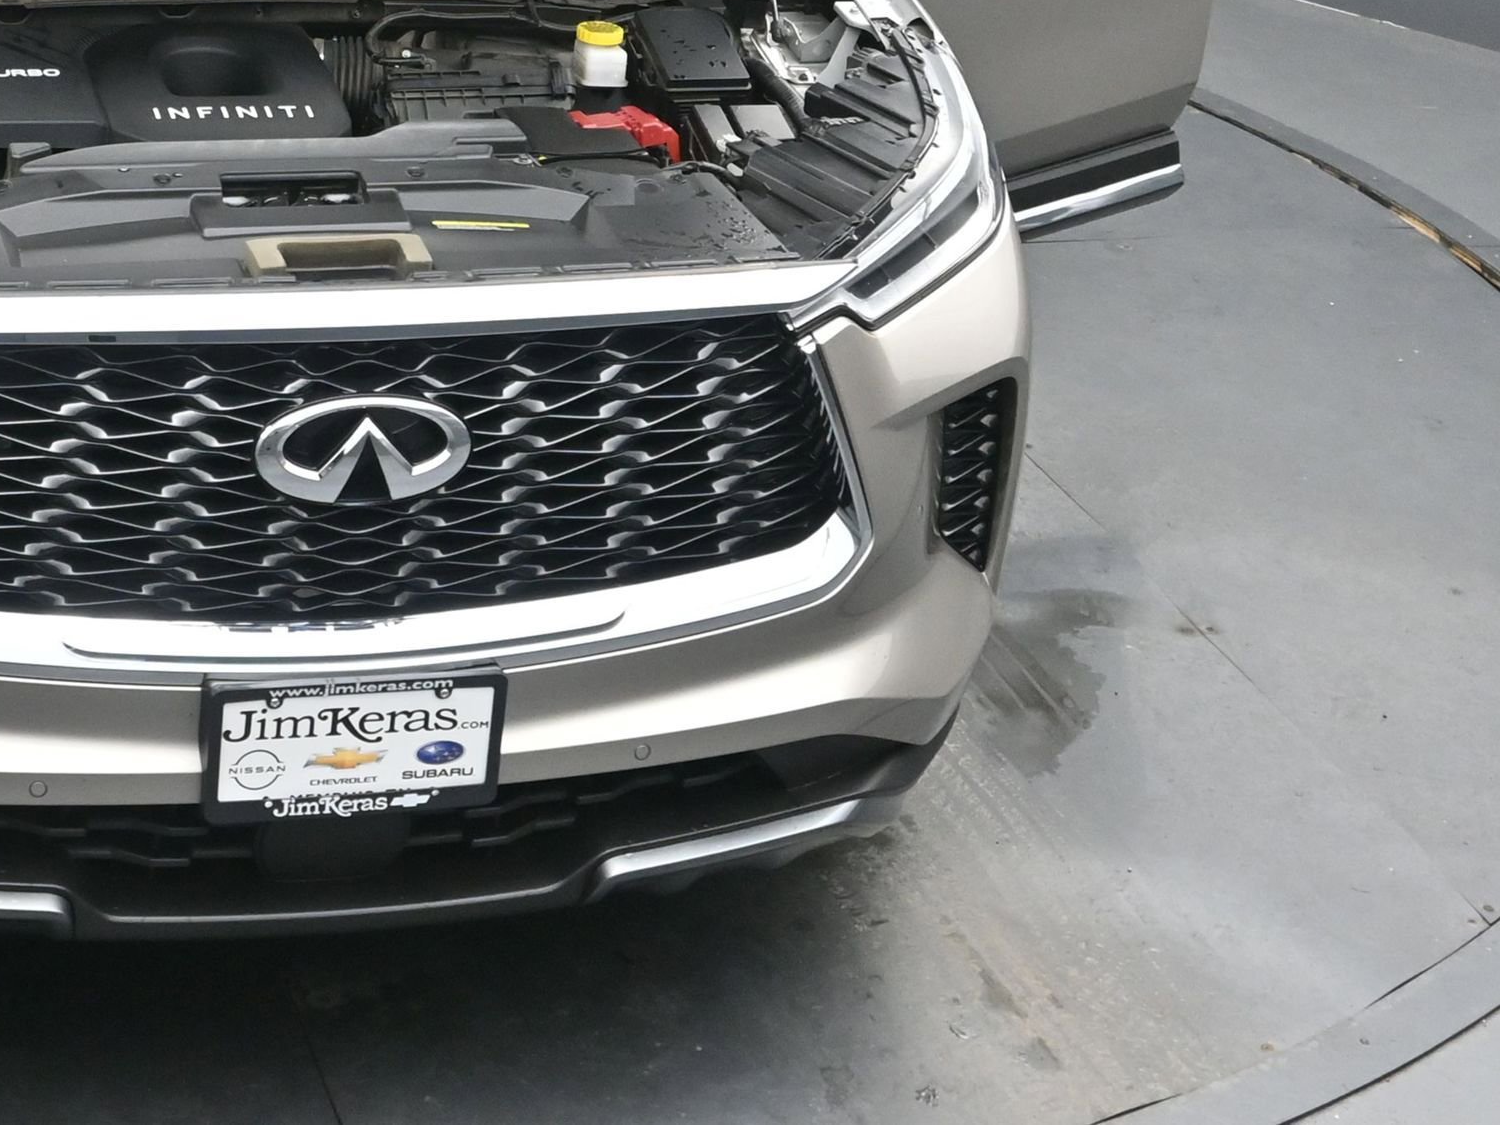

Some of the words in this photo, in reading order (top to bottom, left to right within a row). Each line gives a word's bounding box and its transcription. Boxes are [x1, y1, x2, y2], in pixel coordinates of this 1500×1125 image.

[152, 104, 315, 120] INFINITI
[269, 678, 454, 698] www.jimkeras.com
[228, 765, 286, 775] NISSAN
[402, 767, 474, 780] SUBARU
[309, 776, 378, 786] CHEVROLET
